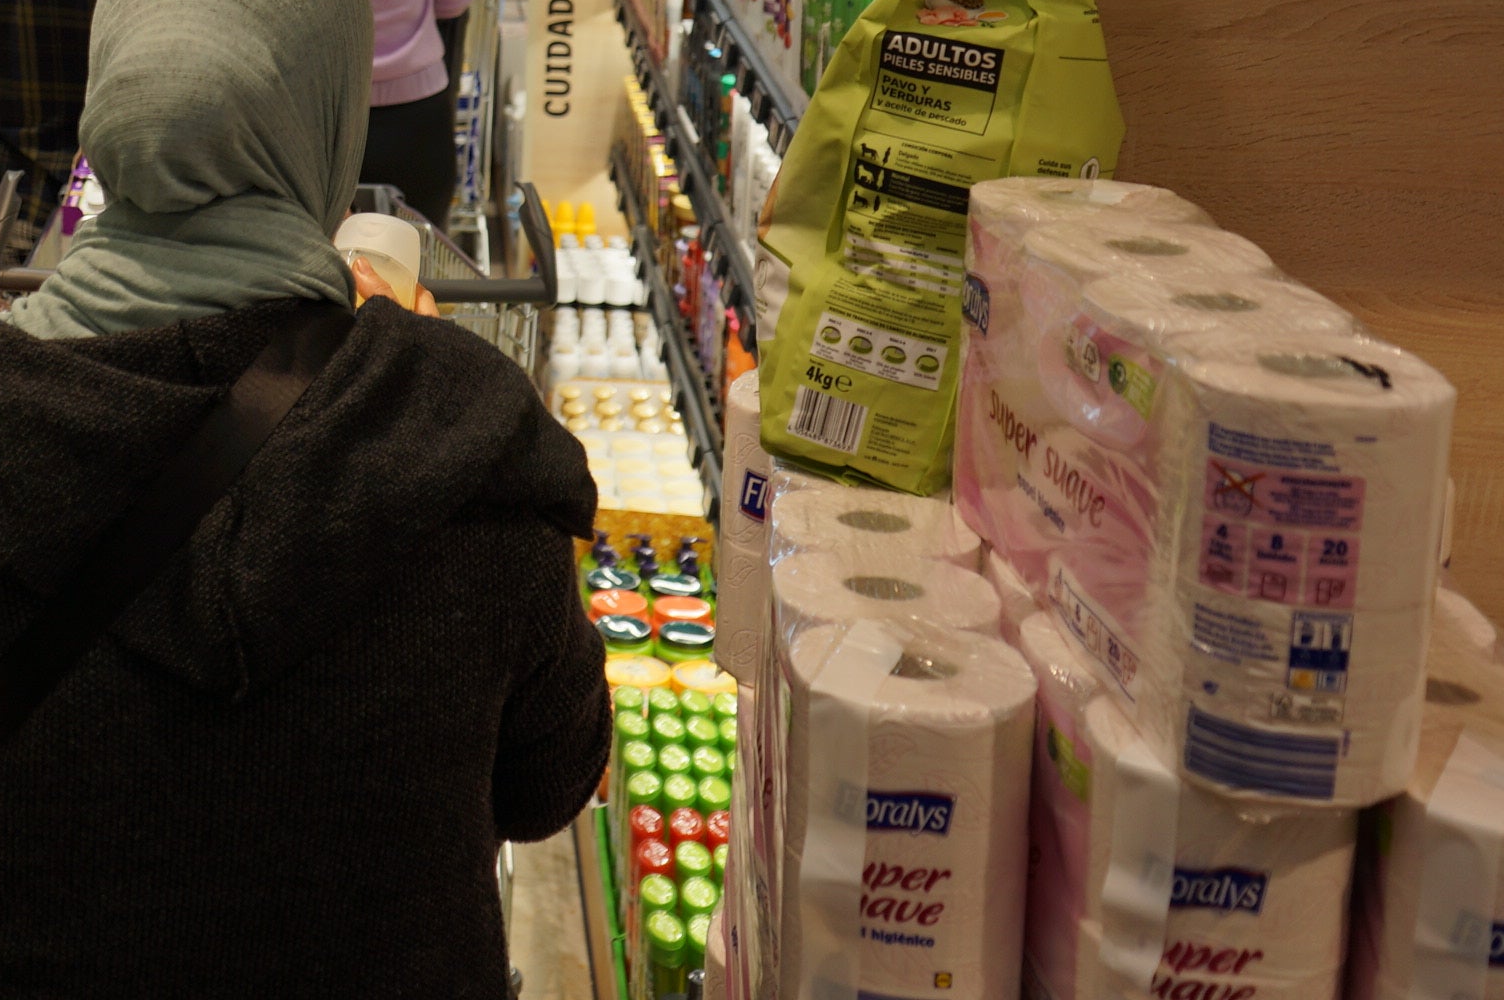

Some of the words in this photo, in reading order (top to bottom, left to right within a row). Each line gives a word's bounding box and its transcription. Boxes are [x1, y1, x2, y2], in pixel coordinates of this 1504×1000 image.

[887, 34, 997, 69] ADULTOS
[883, 52, 925, 73] PIELES
[927, 61, 997, 85] SENSIBLES
[880, 85, 953, 112] VERDURAS
[882, 74, 917, 93] PAVO
[921, 84, 932, 95] Y
[877, 98, 883, 107] y
[885, 100, 913, 114] aceite
[914, 106, 927, 117] de
[928, 109, 967, 127] pescado
[1038, 158, 1059, 168] Cuida
[806, 366, 834, 390] 4kg
[990, 389, 1038, 461] super
[1044, 446, 1106, 528] suave
[1323, 539, 1348, 556] 20
[866, 798, 948, 836] oralys
[862, 861, 952, 895] uper
[1172, 874, 1262, 911] oralys
[871, 927, 936, 949] higiénico
[1163, 941, 1264, 976] uper
[1151, 976, 1258, 1000] uave
